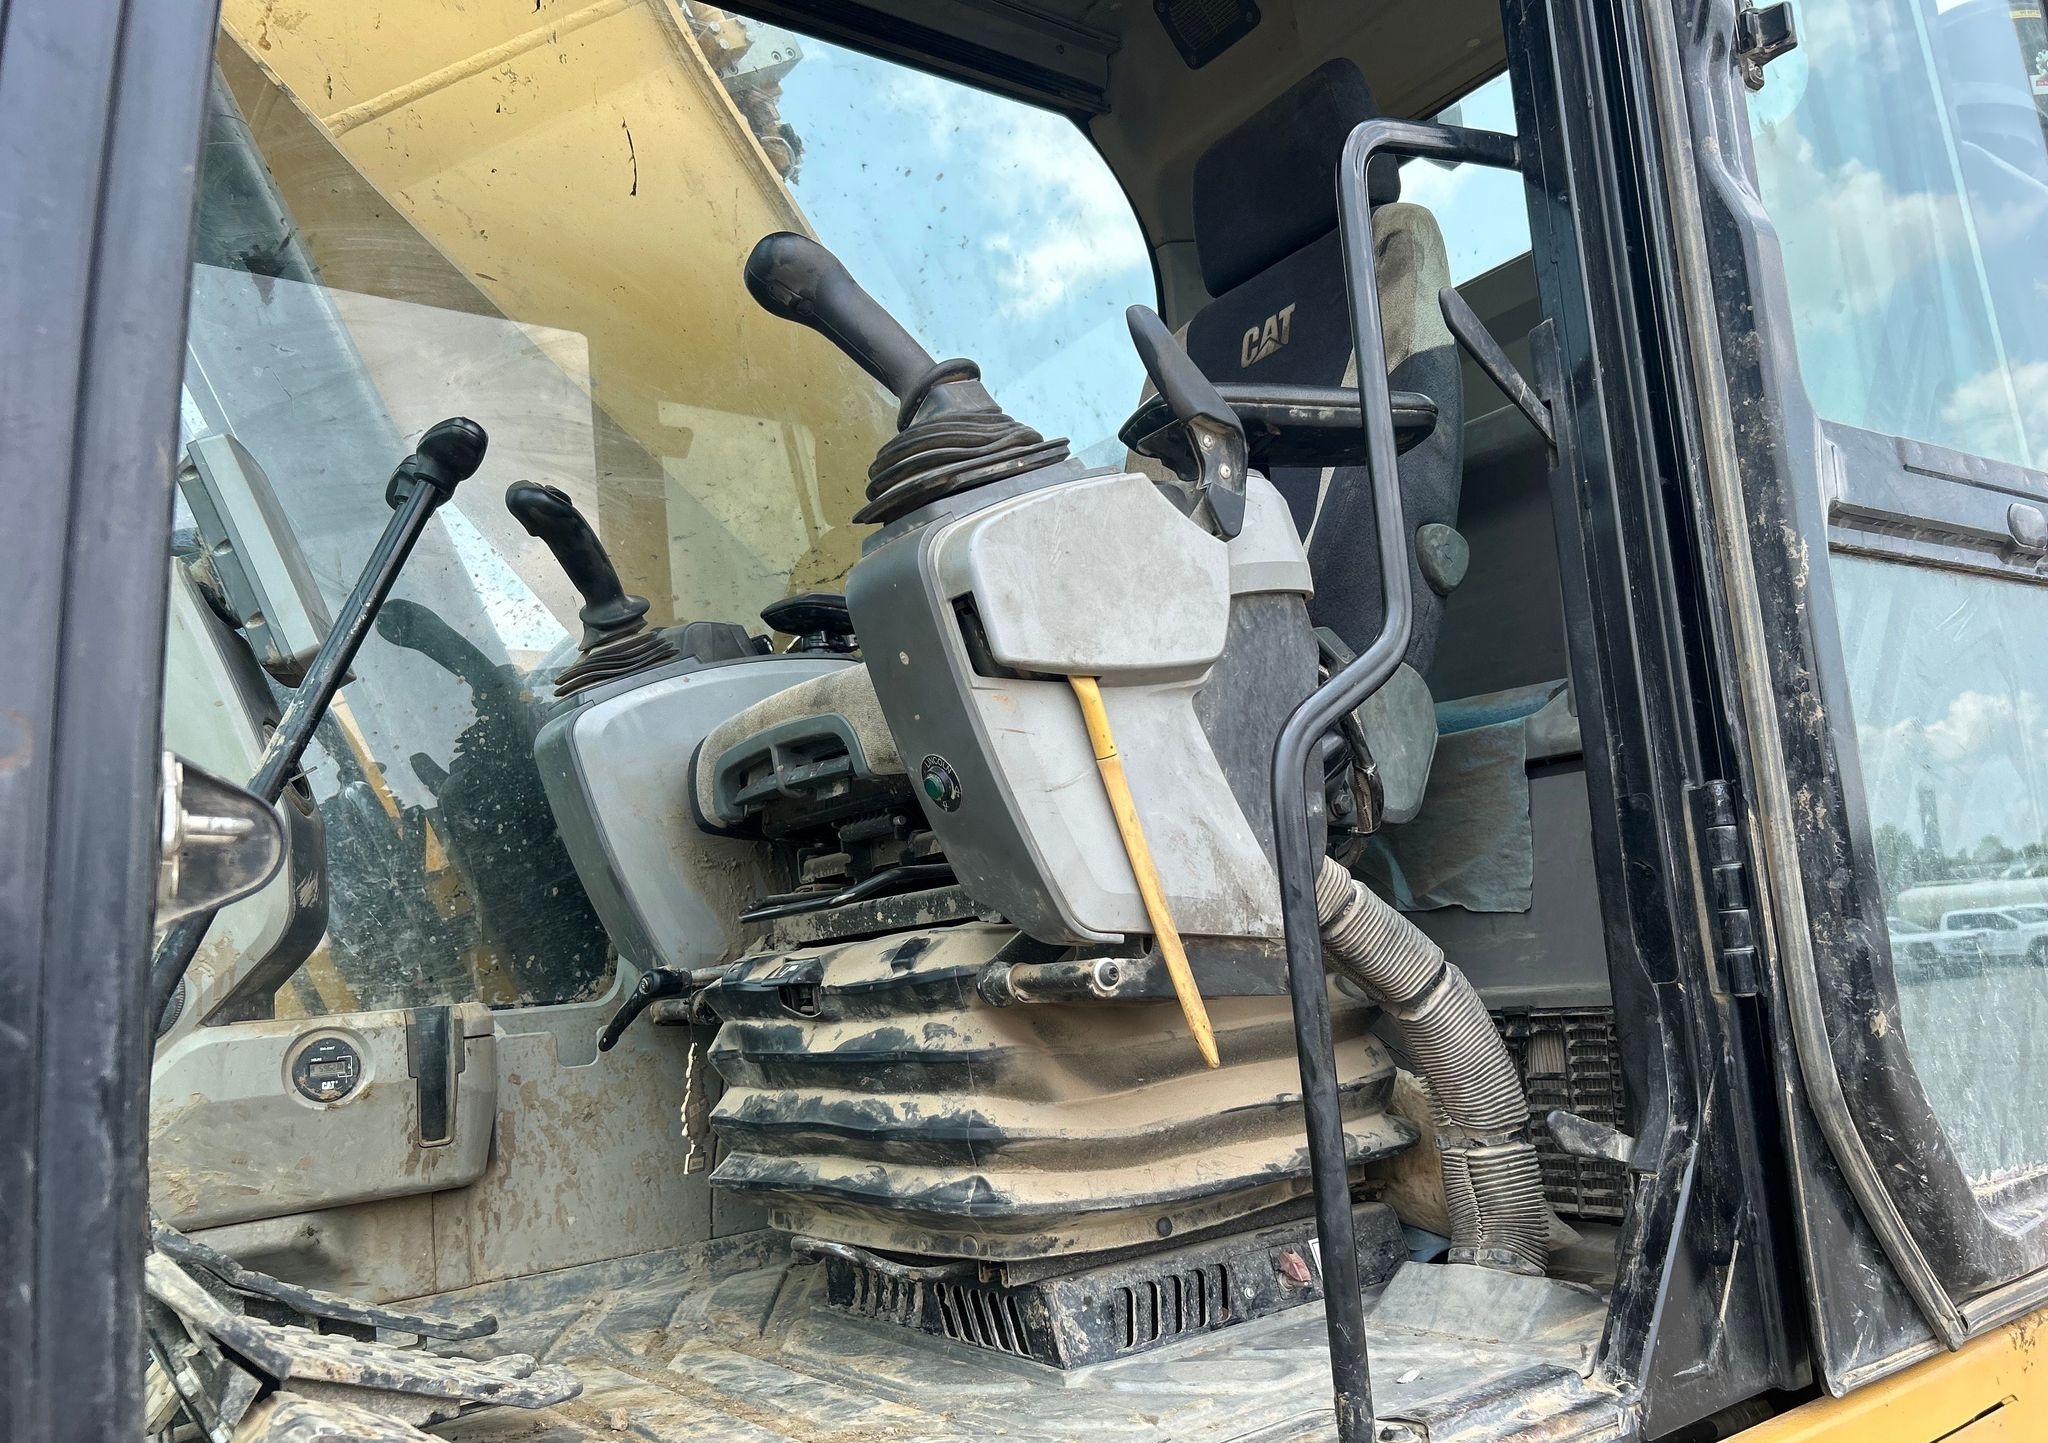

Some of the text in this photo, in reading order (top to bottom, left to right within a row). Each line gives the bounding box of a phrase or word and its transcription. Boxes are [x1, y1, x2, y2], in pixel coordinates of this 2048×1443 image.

[1241, 302, 1296, 368] CAT
[924, 757, 952, 774] LINCOLN
[321, 1081, 336, 1090] CAT
